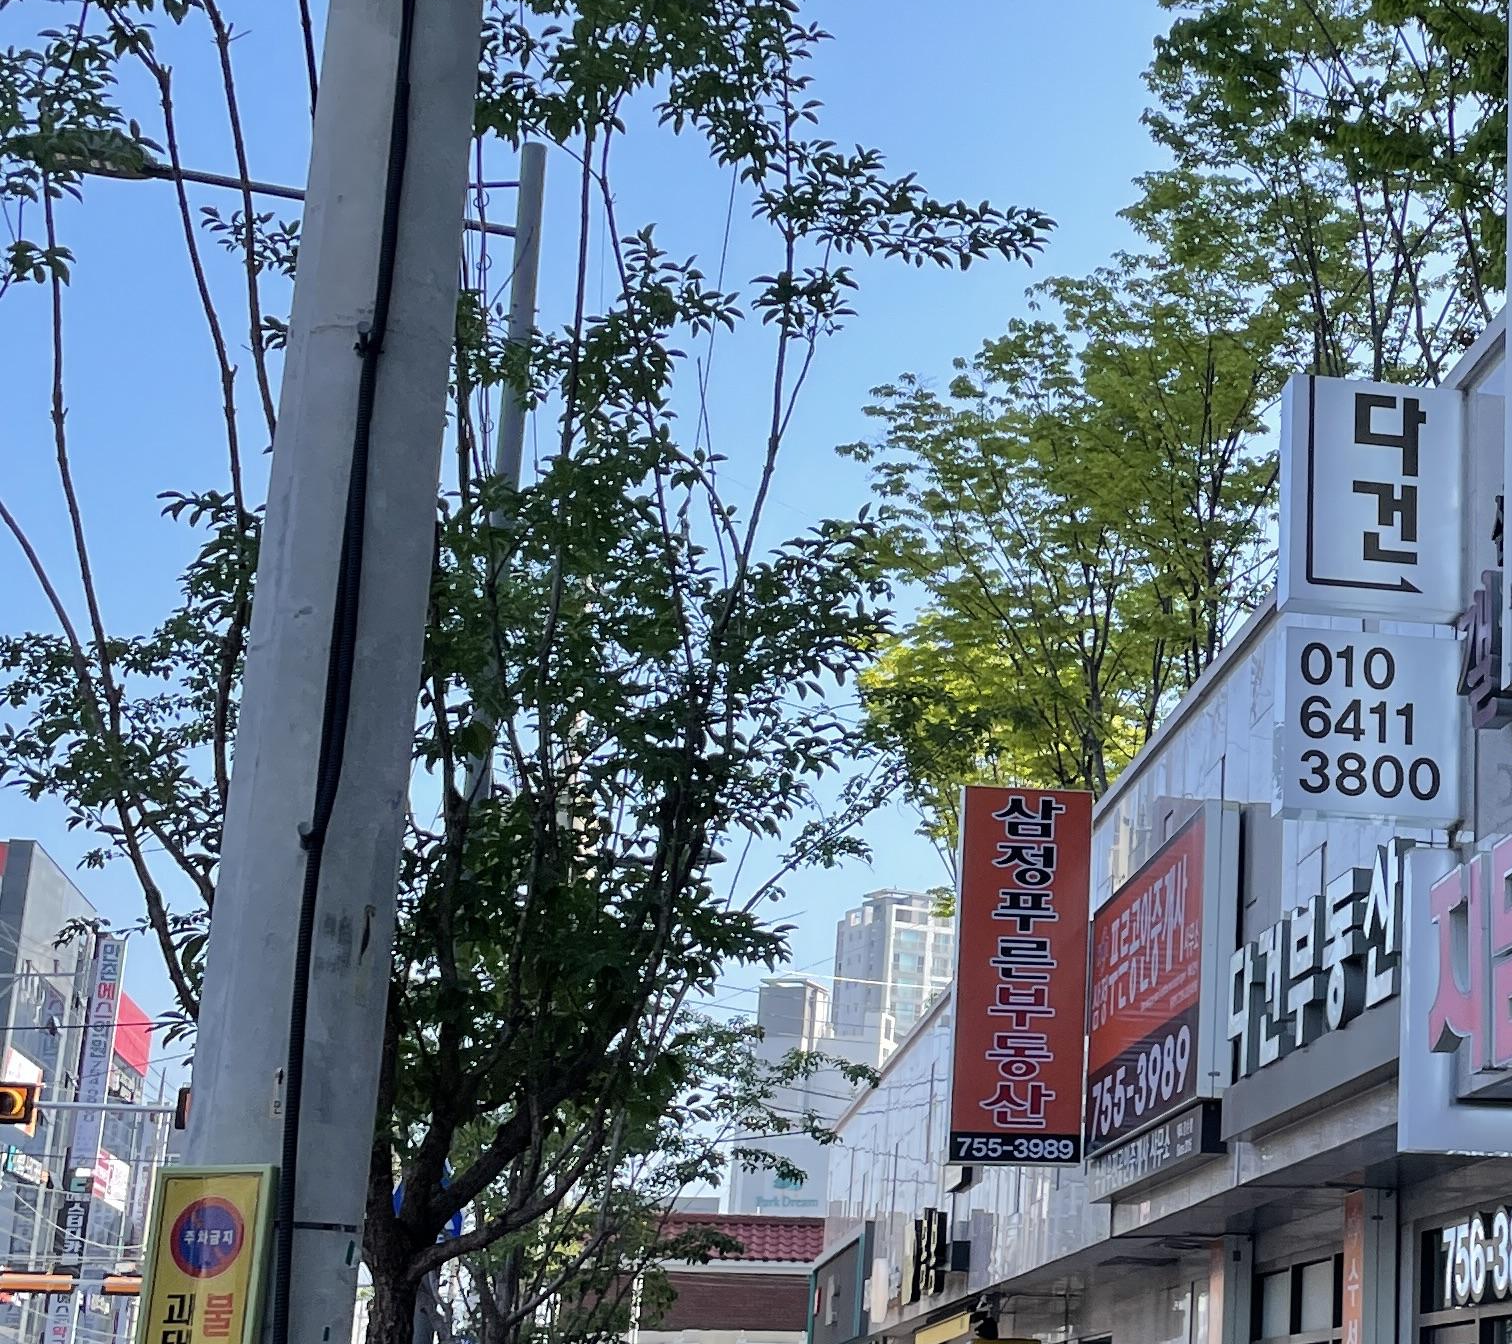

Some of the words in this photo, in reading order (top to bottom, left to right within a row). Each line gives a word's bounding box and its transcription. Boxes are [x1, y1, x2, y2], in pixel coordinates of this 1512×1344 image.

[1353, 392, 1427, 566] 다건
[1300, 642, 1396, 688] 010
[1299, 697, 1415, 747] 6411
[1299, 750, 1442, 801] 3800
[979, 795, 1067, 1131] 삼정푸른부동산
[1227, 845, 1399, 1080] 다건부동산
[1091, 1024, 1191, 1143] 755-3989
[956, 1136, 1075, 1160] 755-3989
[183, 1228, 234, 1246] 주차금지
